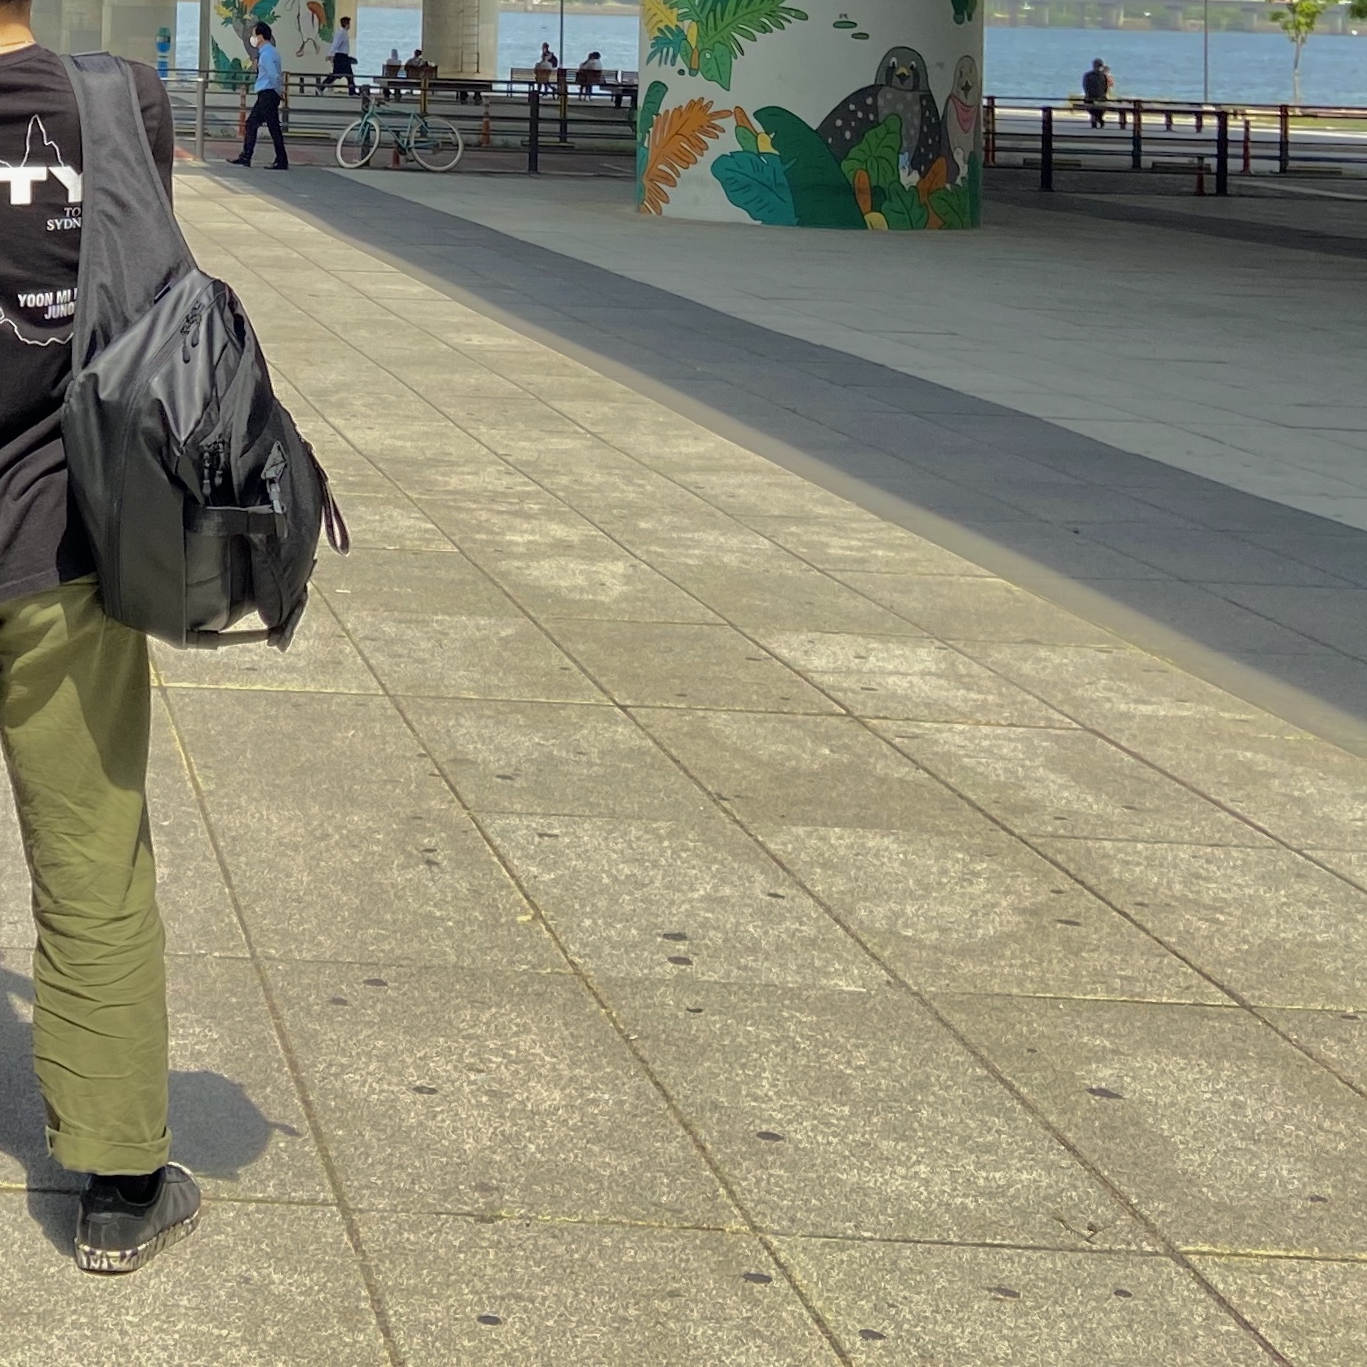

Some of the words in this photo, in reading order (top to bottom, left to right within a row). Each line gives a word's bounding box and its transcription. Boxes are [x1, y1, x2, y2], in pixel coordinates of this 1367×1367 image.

[63, 206, 82, 217] TO
[46, 217, 82, 231] SYDN
[17, 292, 53, 307] YOON
[56, 289, 71, 304] MI
[44, 301, 75, 320] JUNO
